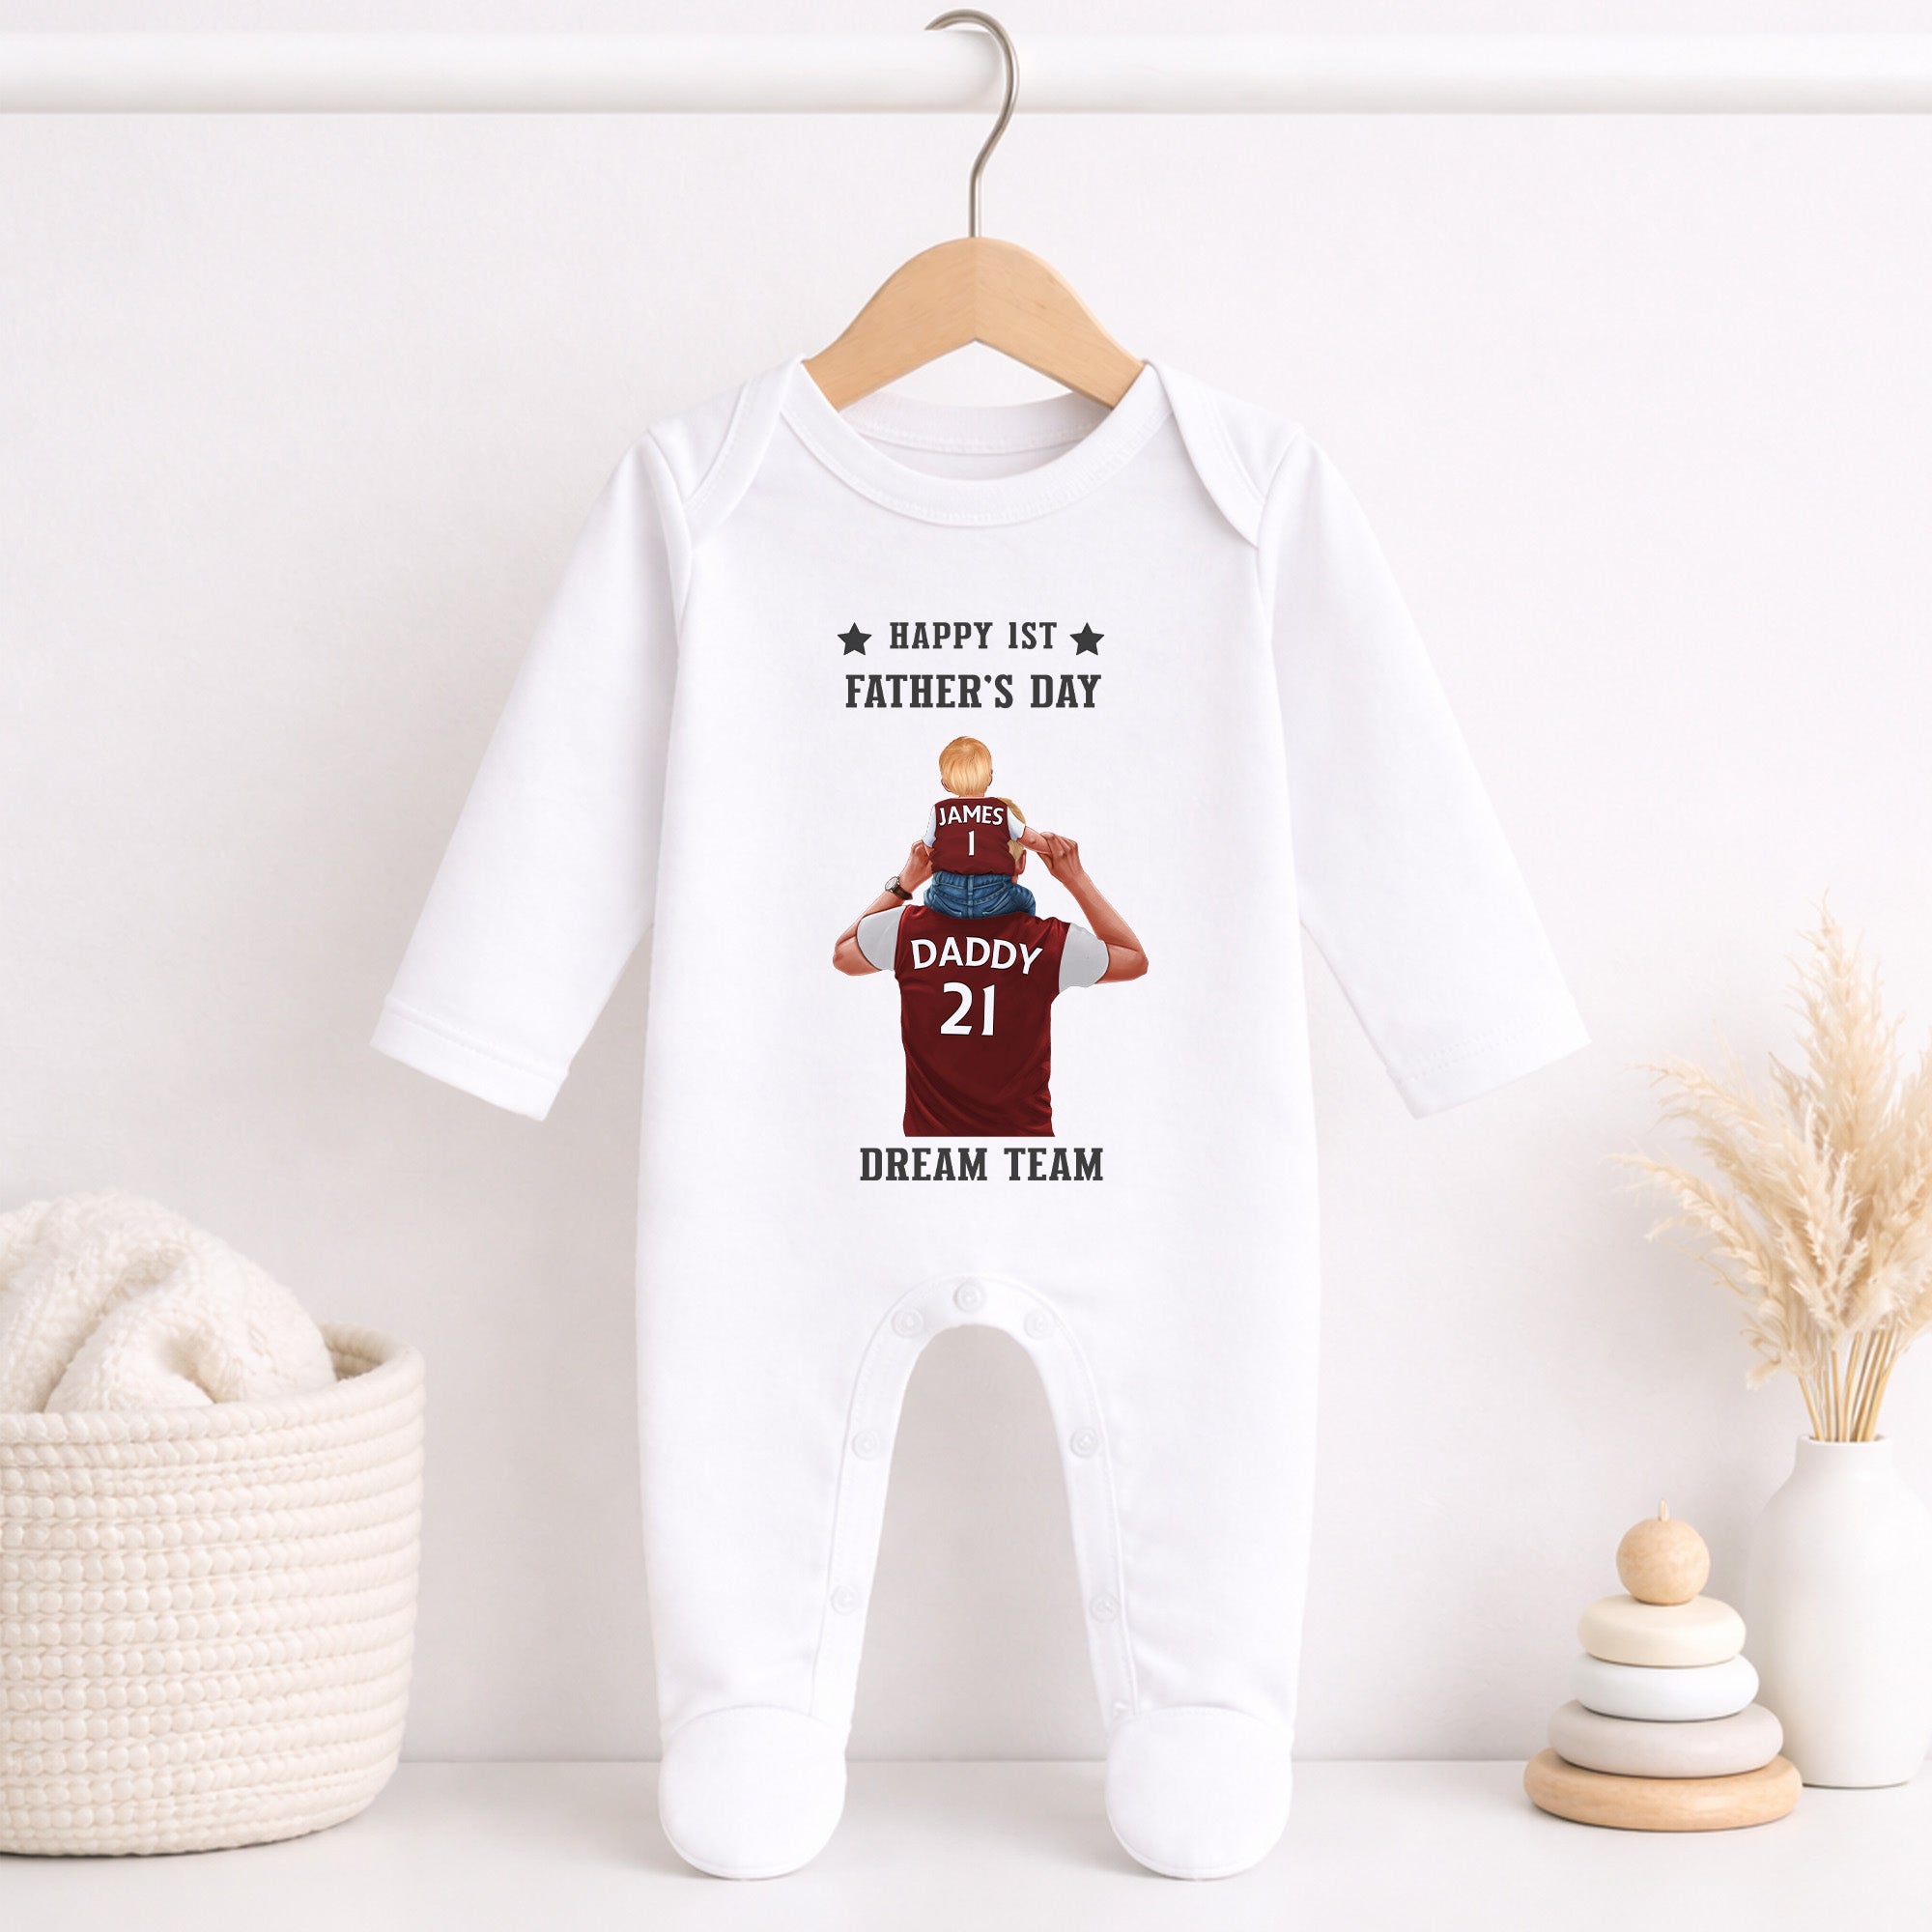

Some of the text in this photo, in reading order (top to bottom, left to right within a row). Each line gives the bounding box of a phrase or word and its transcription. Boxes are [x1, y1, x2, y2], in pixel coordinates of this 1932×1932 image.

[889, 621, 1058, 650] HAPPY 1ST
[845, 674, 1102, 709] FATHER'S DAY
[938, 805, 1005, 827] JAMES
[968, 830, 976, 857] 1
[910, 936, 1043, 975] DADDY
[940, 981, 996, 1037] 21
[860, 1147, 1104, 1181] DREAM TEAM
